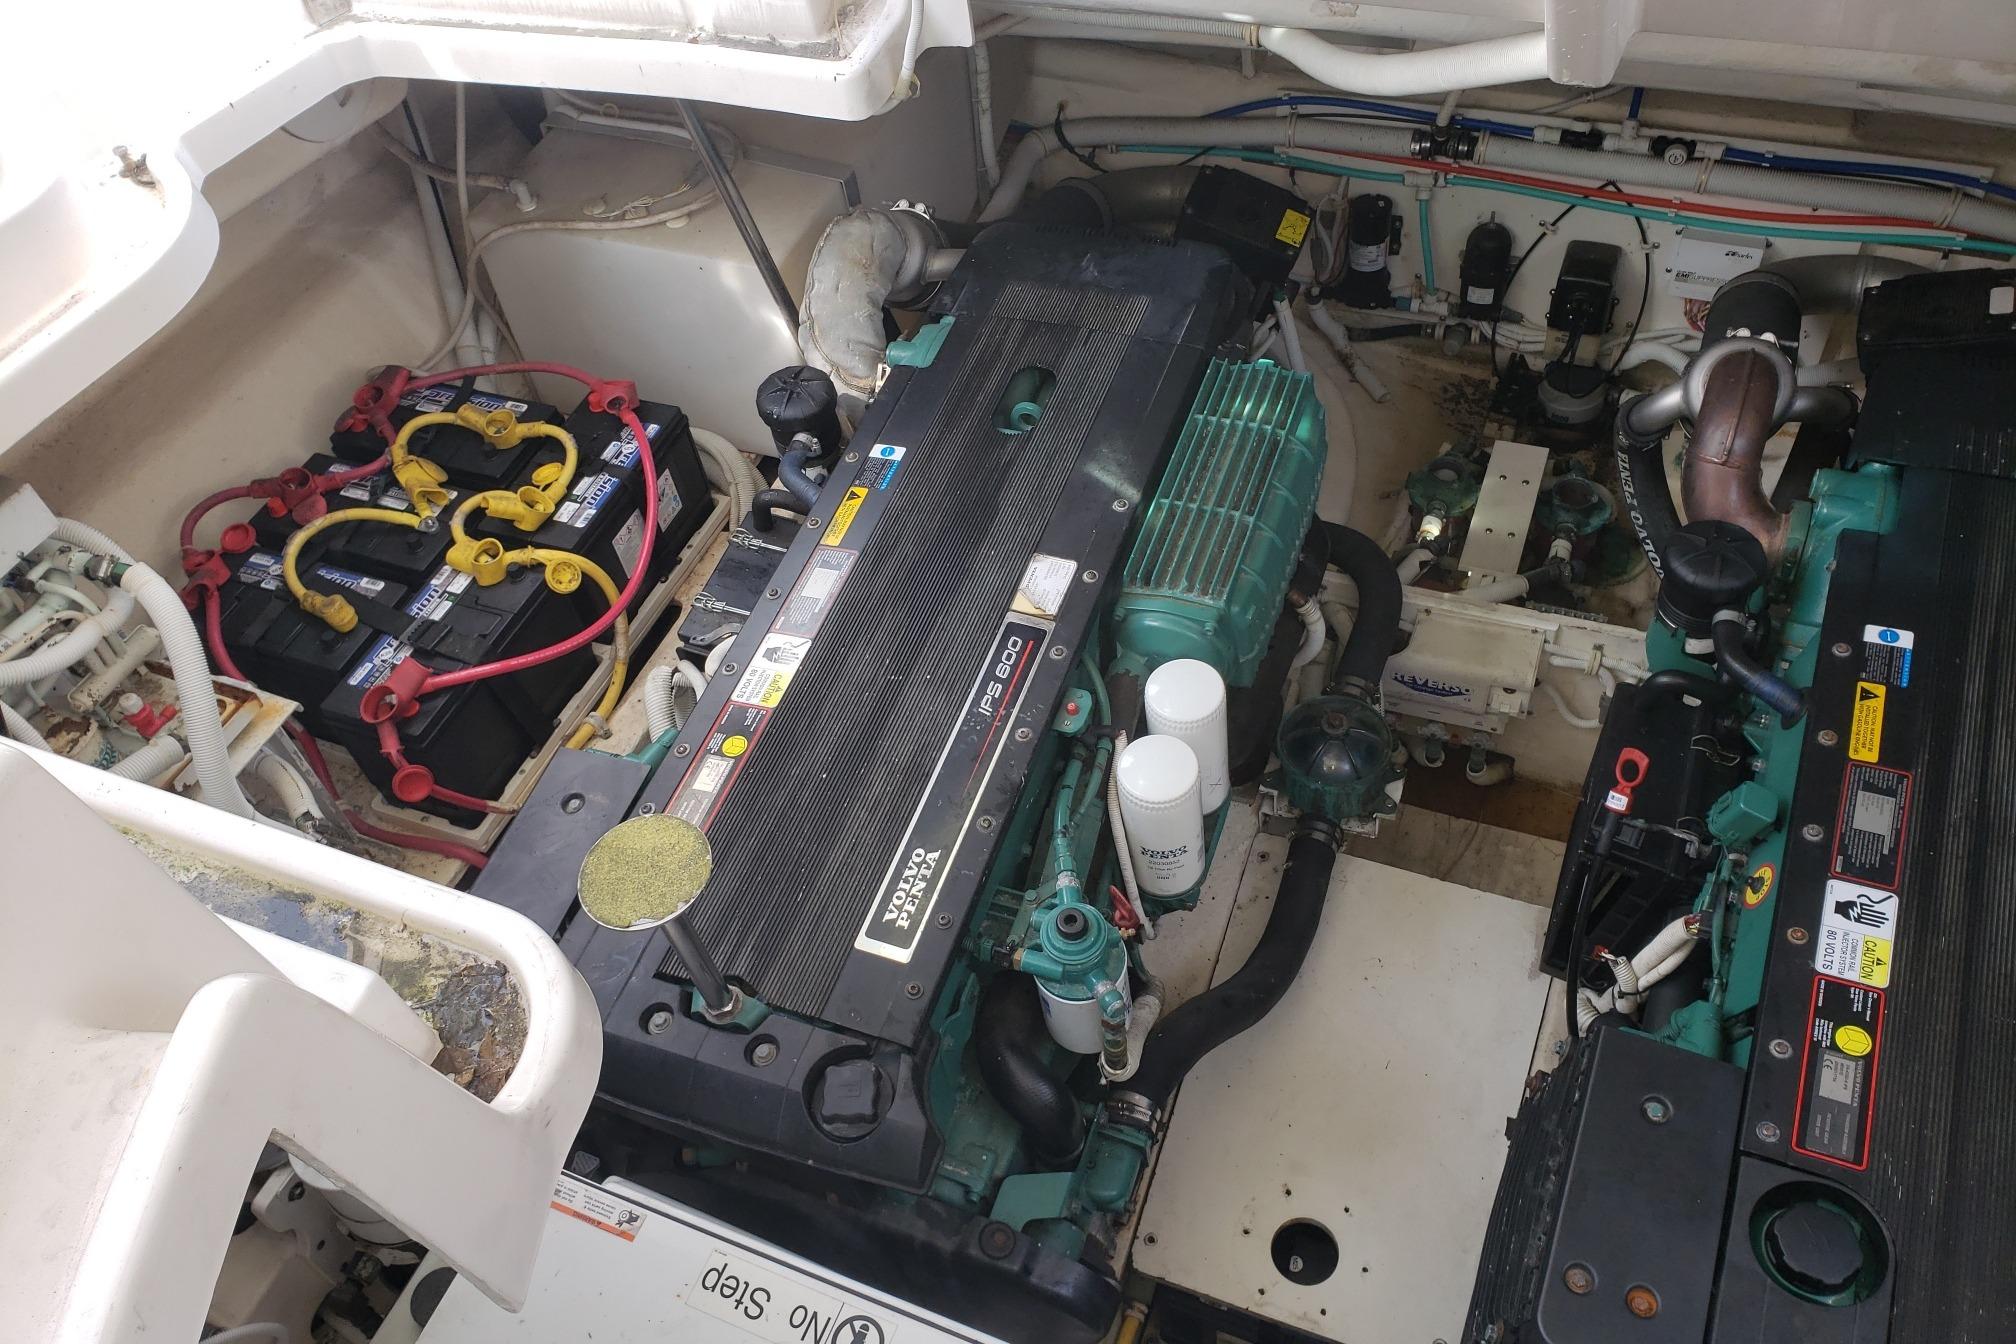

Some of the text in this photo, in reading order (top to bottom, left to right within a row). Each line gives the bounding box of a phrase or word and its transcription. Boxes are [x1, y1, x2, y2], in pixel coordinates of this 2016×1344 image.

[1615, 449, 1664, 578] VOLVO PENTA
[736, 668, 757, 698] 80 VOLTS
[760, 672, 782, 703] CAUTION
[977, 634, 1025, 717] IPS 600
[1391, 671, 1473, 694] REVERSO
[1139, 844, 1186, 855] VOLVO
[1140, 848, 1187, 859] PENTA
[881, 845, 927, 924] VOLVO
[895, 848, 942, 929] PENTA
[1821, 929, 1837, 970] 80 VOLTS
[1836, 931, 1850, 976] INJECTOR SYSTEM
[1847, 937, 1858, 972] COMMON RAIL
[1859, 939, 1877, 980] CAUTION
[700, 1262, 830, 1344] No Step
